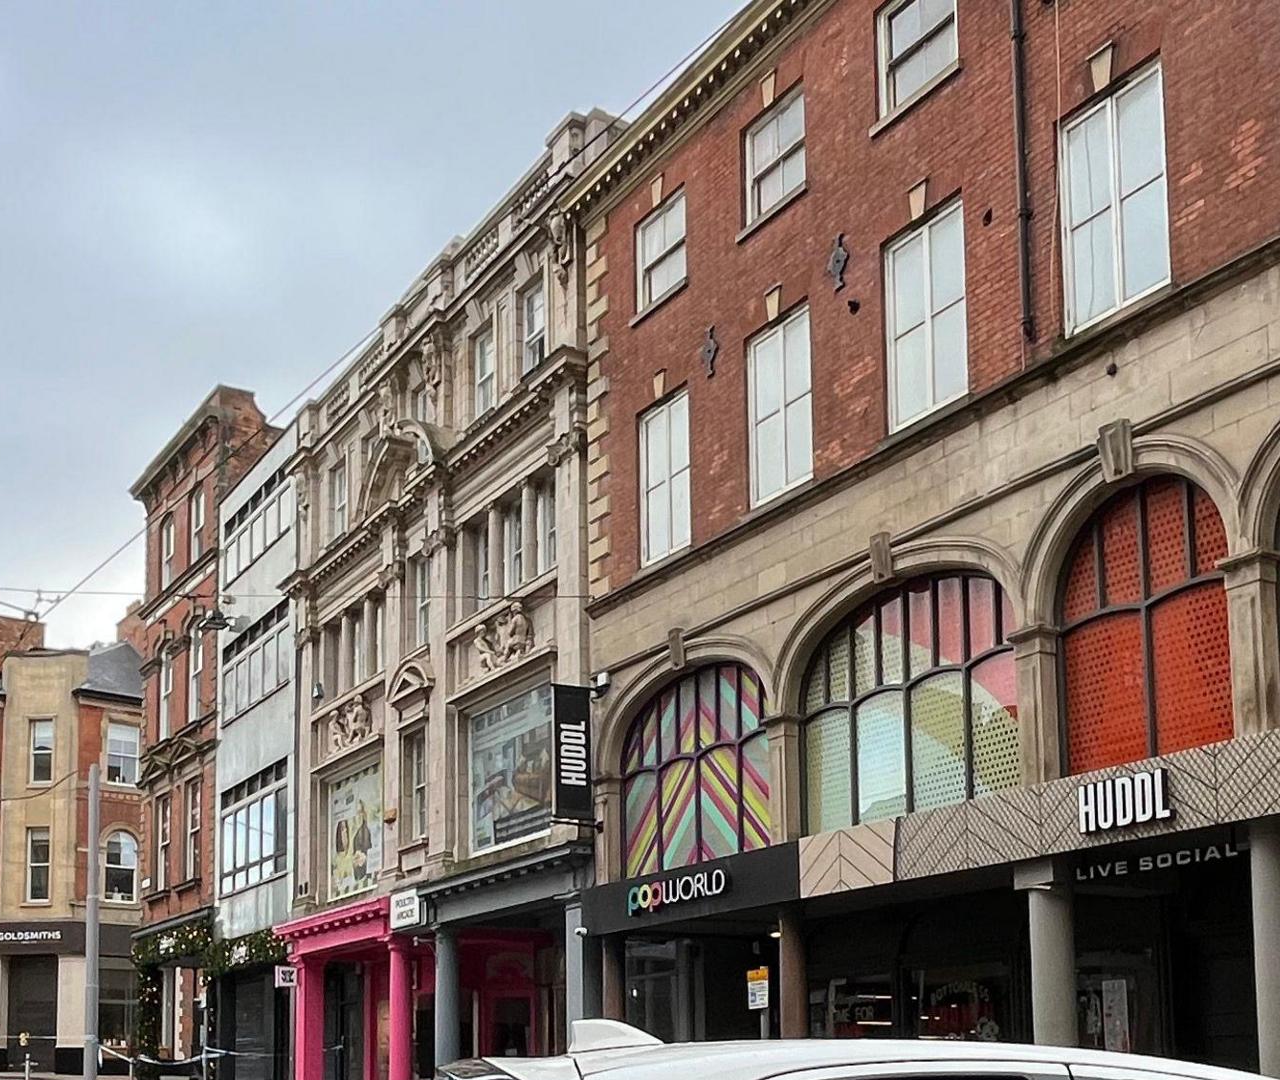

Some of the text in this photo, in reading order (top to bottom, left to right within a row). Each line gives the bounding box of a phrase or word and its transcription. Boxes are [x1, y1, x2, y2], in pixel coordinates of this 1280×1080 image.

[559, 720, 587, 787] HUDDL
[1078, 767, 1171, 834] HUDDL
[1076, 843, 1239, 881] LIVE SOCIAL
